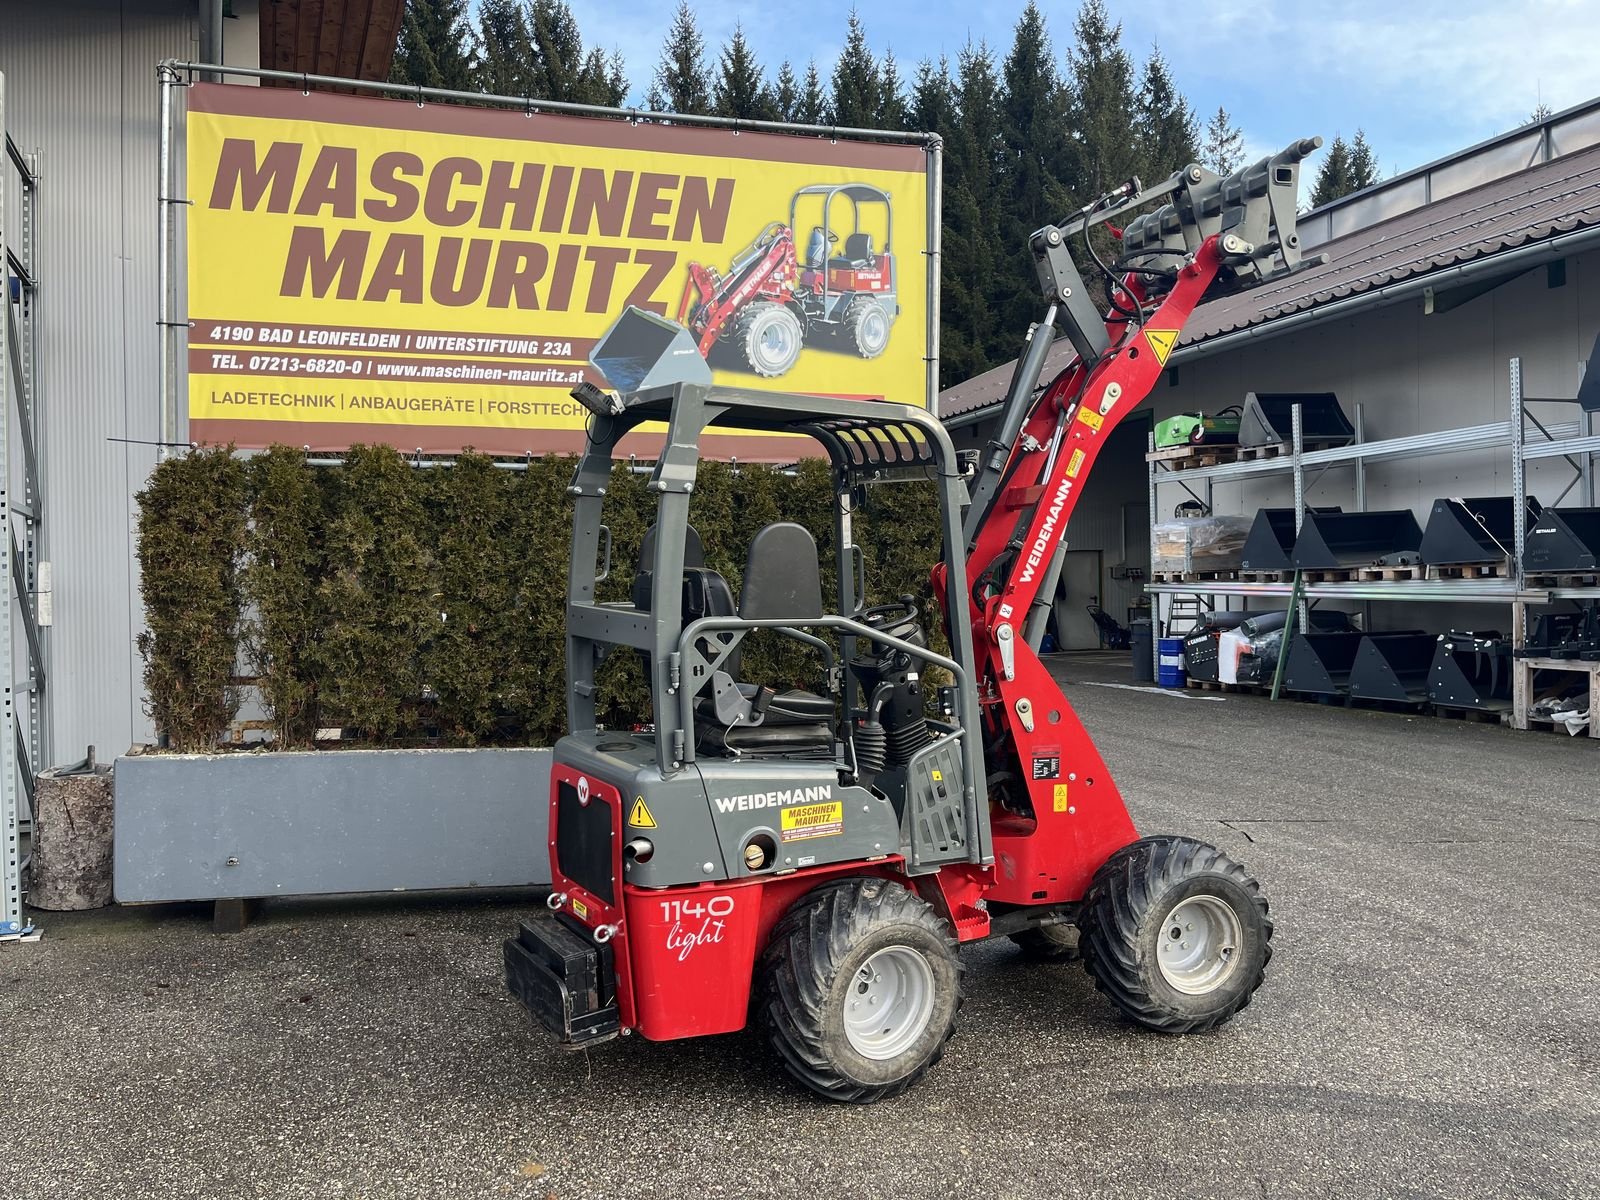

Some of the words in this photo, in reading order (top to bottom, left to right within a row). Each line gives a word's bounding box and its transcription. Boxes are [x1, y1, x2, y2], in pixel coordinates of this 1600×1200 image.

[208, 137, 736, 244] MASCHINEN
[279, 225, 678, 316] MAURITZ
[210, 326, 254, 342] 4190
[258, 327, 293, 343] BAD
[298, 330, 401, 348] LEONFELDEN
[415, 336, 538, 355] UNTERSTIFTUNG
[543, 342, 572, 356] 23A
[212, 354, 243, 369] TEL.
[249, 356, 362, 374] 07213-6820-0
[377, 364, 584, 383] www.maschinen-mauritz.at
[211, 391, 336, 408] LADETECHNIK
[349, 396, 475, 412] ANBAUGERÄTE
[488, 401, 588, 416] FORSTTECH
[1019, 479, 1072, 583] WEIDEMANN
[715, 785, 832, 813] WEIDEMANN
[789, 804, 836, 819] MASCHINEN
[795, 814, 831, 827] MAURITZ
[660, 896, 734, 922] 1140
[666, 917, 726, 961] light
